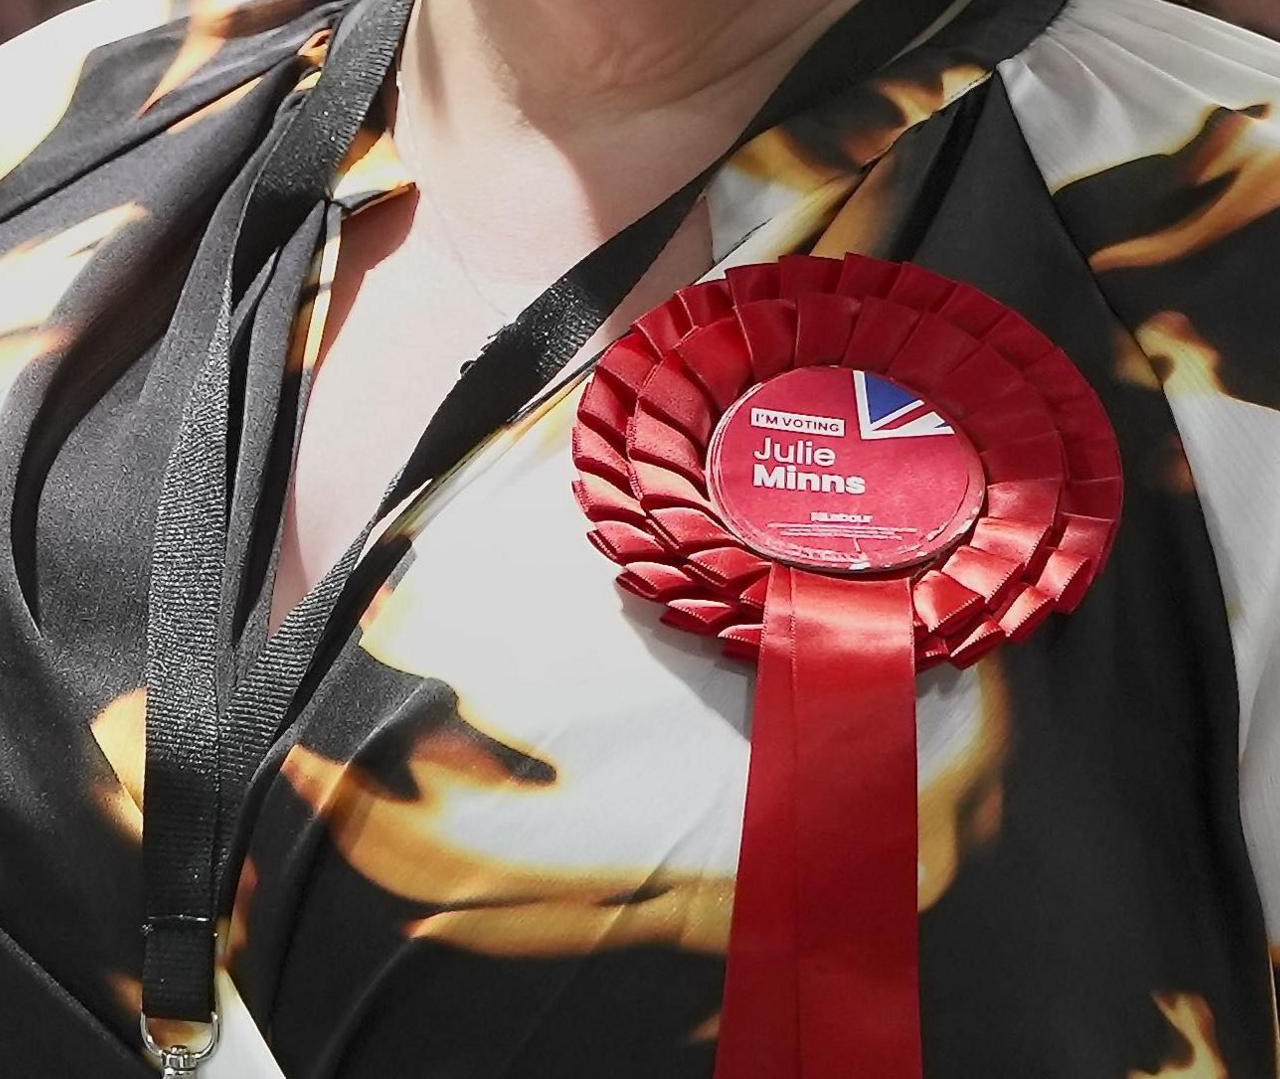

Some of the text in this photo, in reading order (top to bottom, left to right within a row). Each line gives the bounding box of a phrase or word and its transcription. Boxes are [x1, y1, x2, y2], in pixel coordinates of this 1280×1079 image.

[756, 413, 840, 432] I'M VOTING
[753, 437, 836, 467] Julie
[753, 463, 866, 495] Minns
